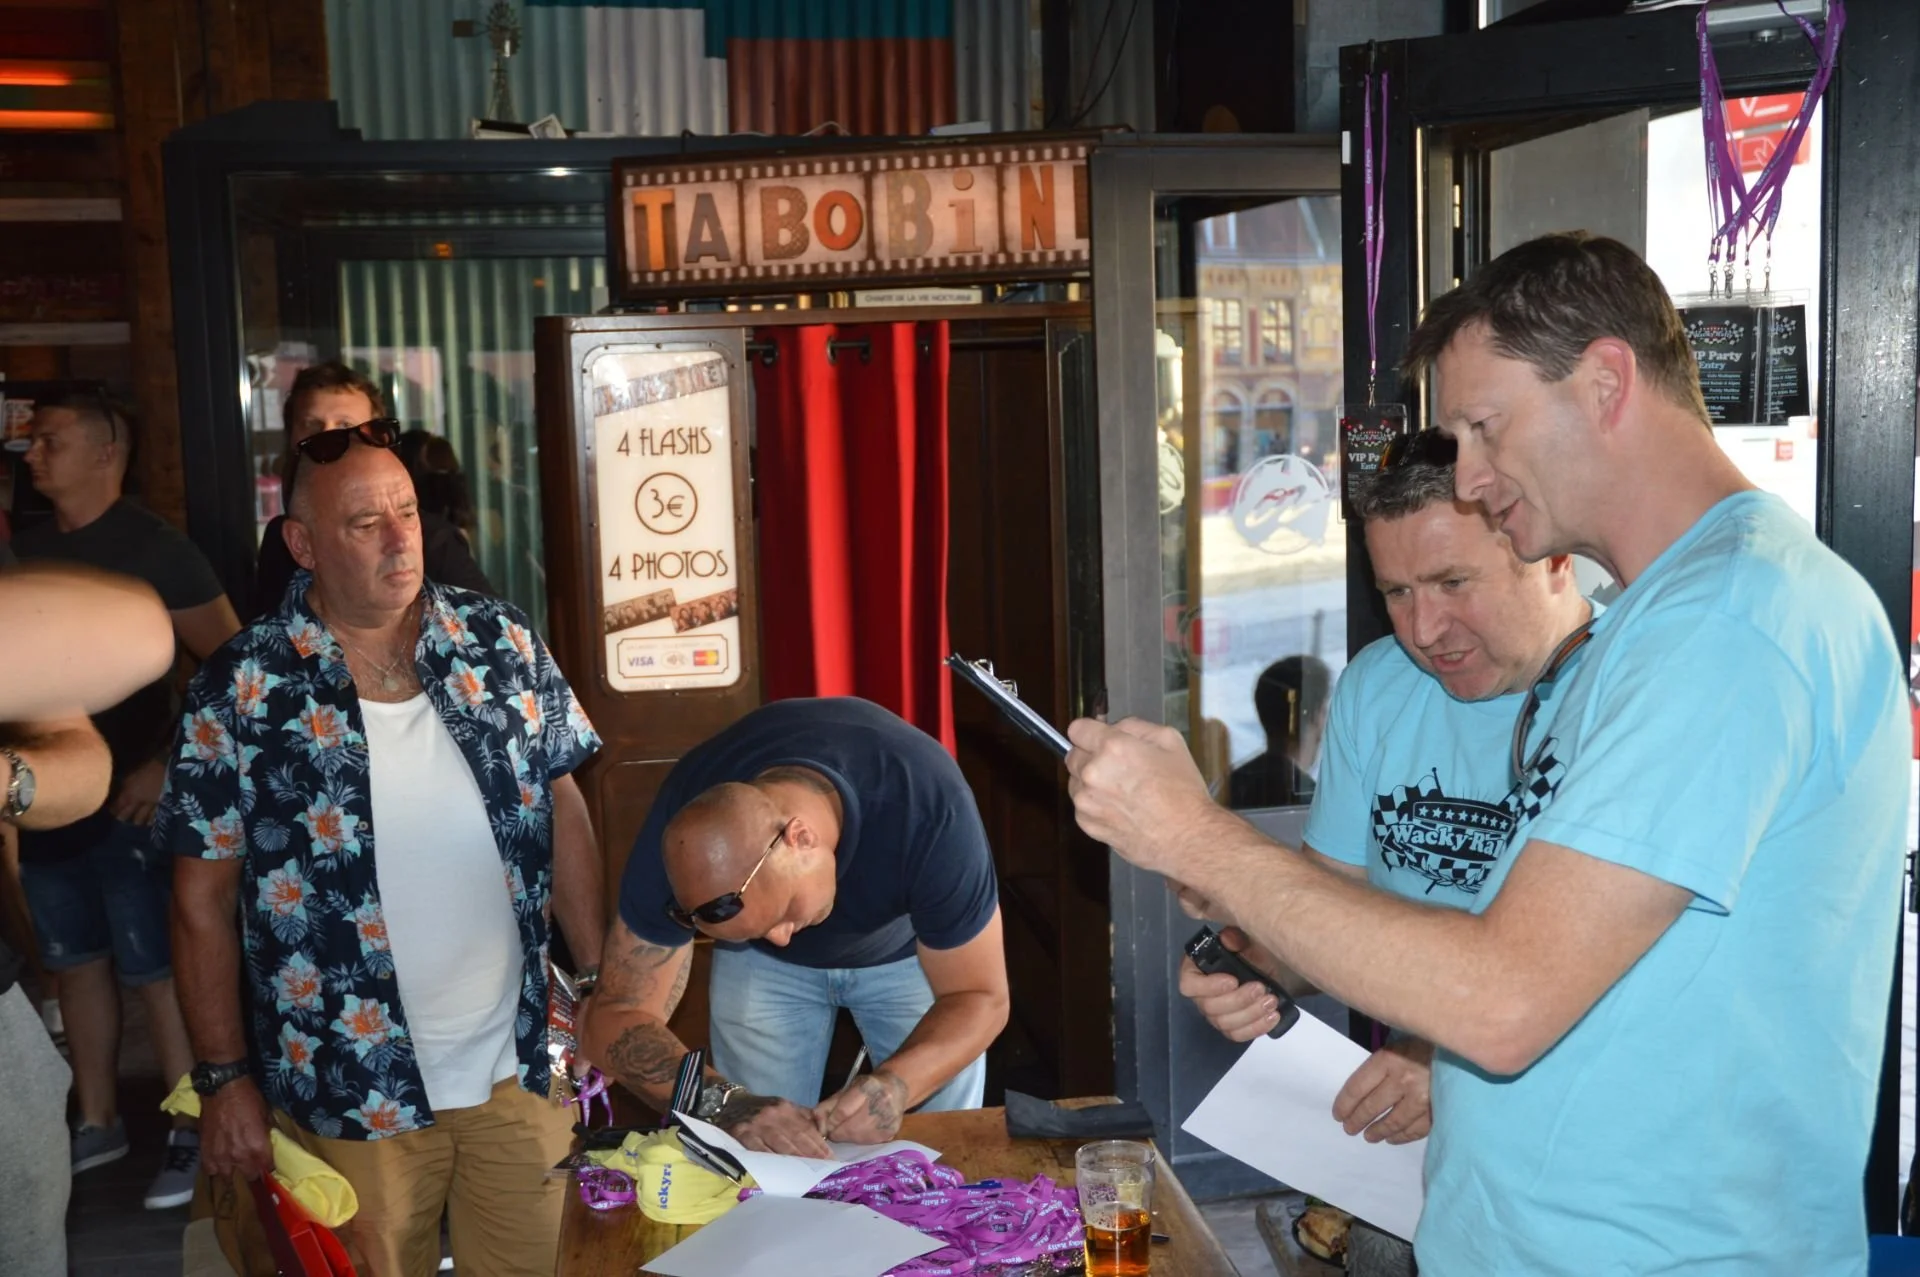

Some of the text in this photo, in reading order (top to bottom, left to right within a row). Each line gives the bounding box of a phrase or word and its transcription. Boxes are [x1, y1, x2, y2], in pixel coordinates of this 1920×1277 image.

[1693, 350, 1742, 362] IP Party
[1698, 361, 1726, 370] Entry
[616, 426, 712, 457] 4 FLASHS
[1348, 453, 1367, 462] VIP
[650, 488, 686, 518] 3€
[608, 550, 728, 581] 4 PHOTOS
[628, 655, 655, 667] VISA
[1391, 823, 1470, 852] Wacky
